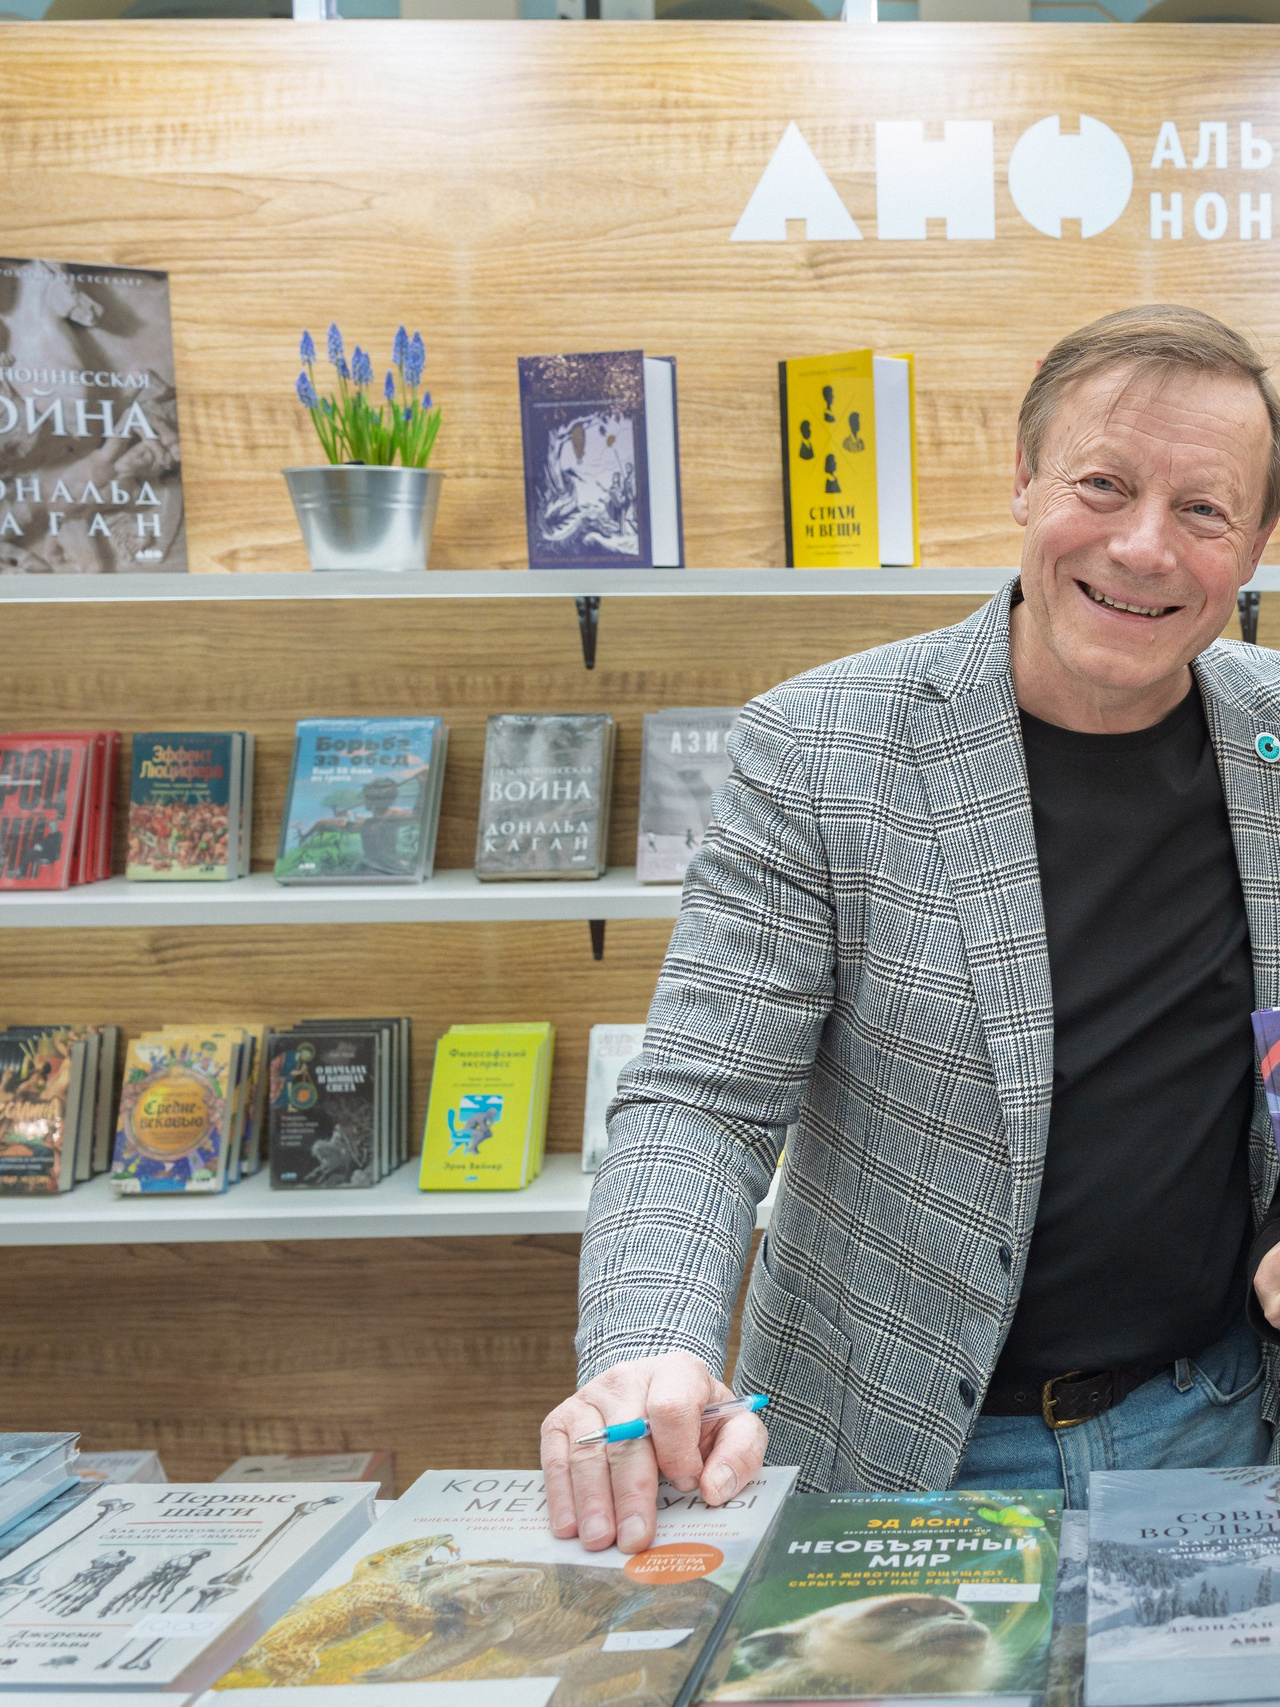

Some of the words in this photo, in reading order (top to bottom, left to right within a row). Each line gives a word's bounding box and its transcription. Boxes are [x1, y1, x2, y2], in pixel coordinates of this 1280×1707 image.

[809, 505, 856, 520] СТИХИ
[805, 524, 815, 537] И
[819, 523, 861, 537] ВЕЩИ
[315, 735, 411, 754] Борьба
[152, 744, 214, 766] Эффект
[313, 755, 340, 767] за
[350, 754, 410, 767] обед
[139, 760, 224, 783] Люцифера
[488, 776, 593, 801] ВОЙНА
[485, 820, 590, 837] ДОНАЛЬД
[484, 836, 589, 853] КАГАН
[153, 1491, 296, 1507] Первые
[158, 1507, 258, 1518] шаги
[866, 1518, 900, 1529] ЭД
[910, 1516, 974, 1527] ЙОНГ
[1139, 1526, 1189, 1539] ВО
[787, 1534, 1038, 1554] НЕОБЪЯТНЫЙ
[1157, 1545, 1222, 1554] САМОГО
[645, 1558, 704, 1566] ПИТЕРА
[868, 1554, 951, 1568] МИР
[634, 1564, 707, 1573] ШАУТЕНА
[806, 1572, 834, 1580] КАК
[840, 1571, 920, 1579] ЖИВОТНЫЕ
[926, 1569, 1004, 1578] ОЩУЩАЮТ
[788, 1580, 861, 1588] СКРЫТУЮ
[866, 1579, 885, 1587] ОТ
[890, 1578, 919, 1586] НАС
[925, 1577, 1019, 1585] РЕАЛЬНОСТЬ
[1167, 1621, 1273, 1634] ДЖОНАТАН
[10, 1630, 102, 1640] Джереми
[1, 1640, 89, 1649] Десильва
